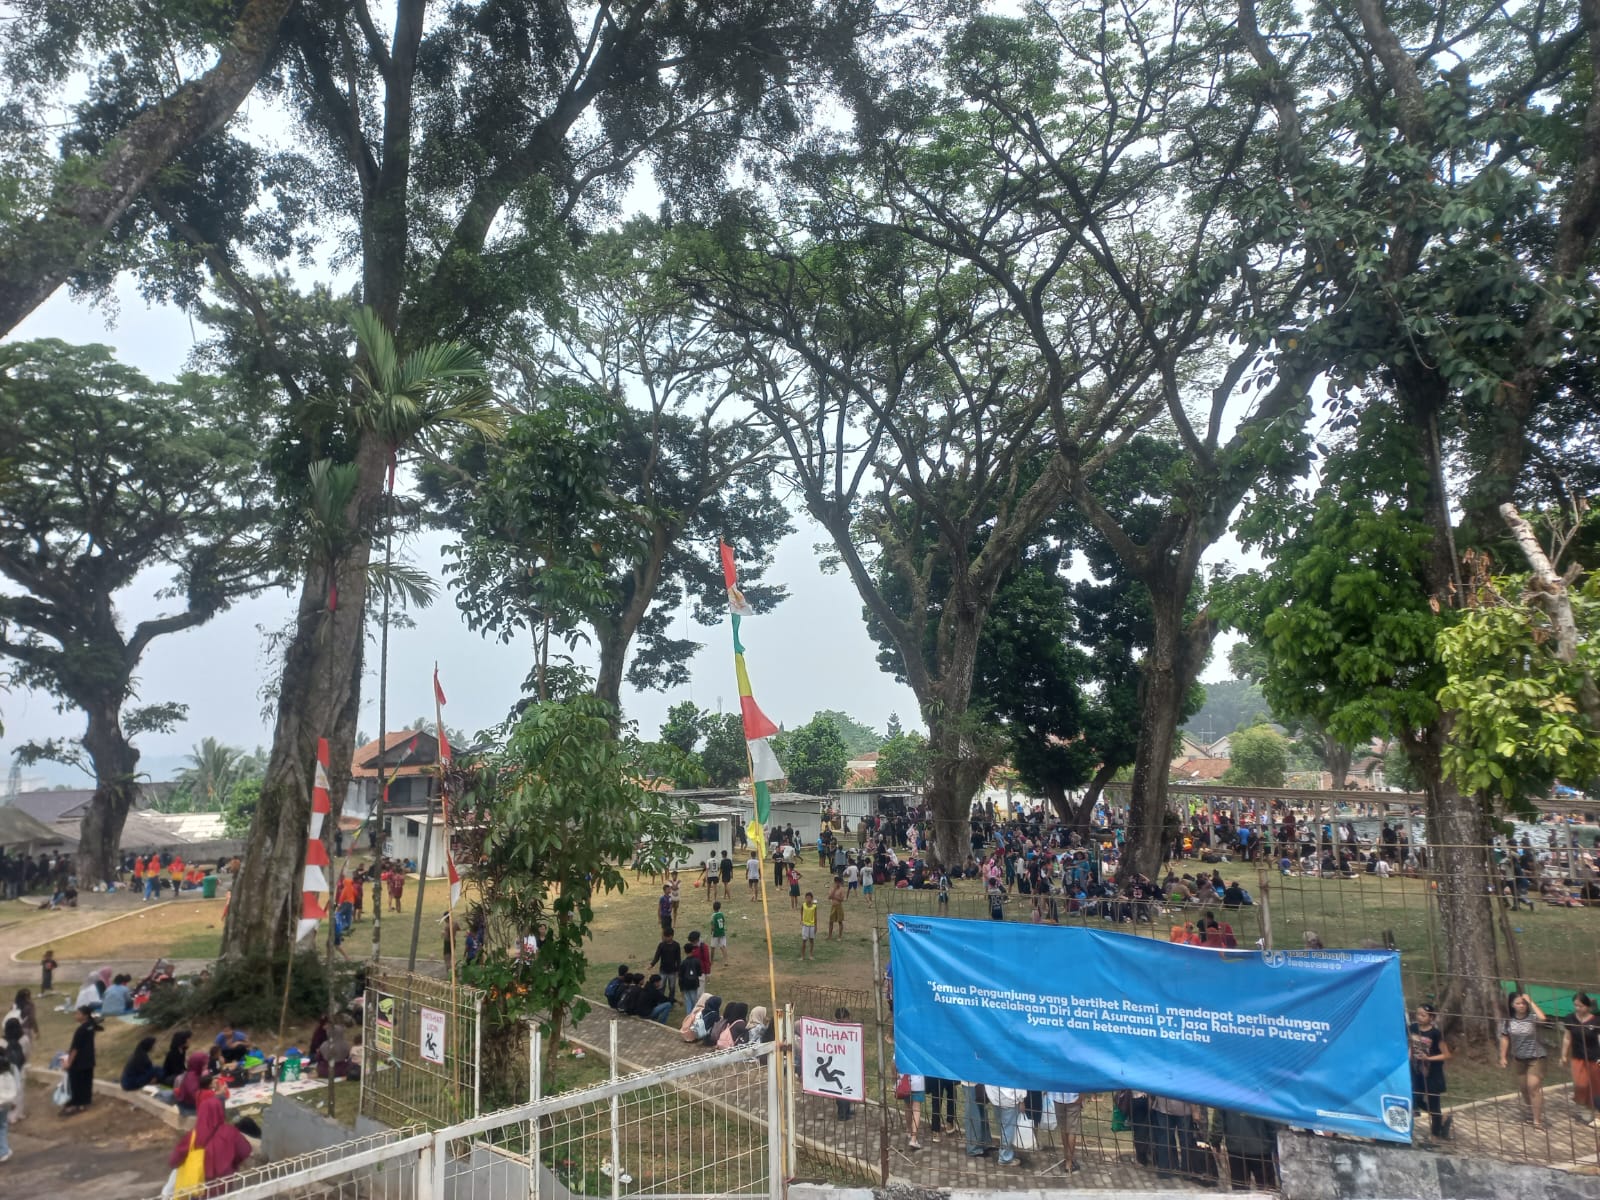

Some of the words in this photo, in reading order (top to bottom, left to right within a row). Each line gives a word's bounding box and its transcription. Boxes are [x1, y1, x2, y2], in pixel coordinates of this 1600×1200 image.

[927, 981, 967, 995] "Semua
[969, 985, 1036, 1003] Pengunjung
[1039, 994, 1068, 1006] yang
[1071, 995, 1120, 1010] bertiket
[1122, 1000, 1159, 1014] Resmi
[1166, 1005, 1233, 1025] mendapat
[1236, 1013, 1330, 1031] perlindungan
[934, 993, 979, 1006] Asuransi
[981, 999, 1046, 1014] Kecelakaan
[1050, 1004, 1071, 1016] Diri
[1073, 1007, 1098, 1019] dari
[1101, 1010, 1153, 1025] Asuransi
[1156, 1016, 1178, 1028] PT.
[1181, 1017, 1208, 1031] Jasa
[1211, 1020, 1265, 1038] Raharja
[1268, 1026, 1328, 1043] Putera".
[805, 1024, 858, 1042] HATI-HATI
[1027, 1013, 1065, 1027] Syarat
[1067, 1017, 1090, 1030] dan
[1093, 1021, 1157, 1038] ketentuan
[1160, 1026, 1211, 1043] berlaku
[816, 1041, 846, 1055] LICIN
